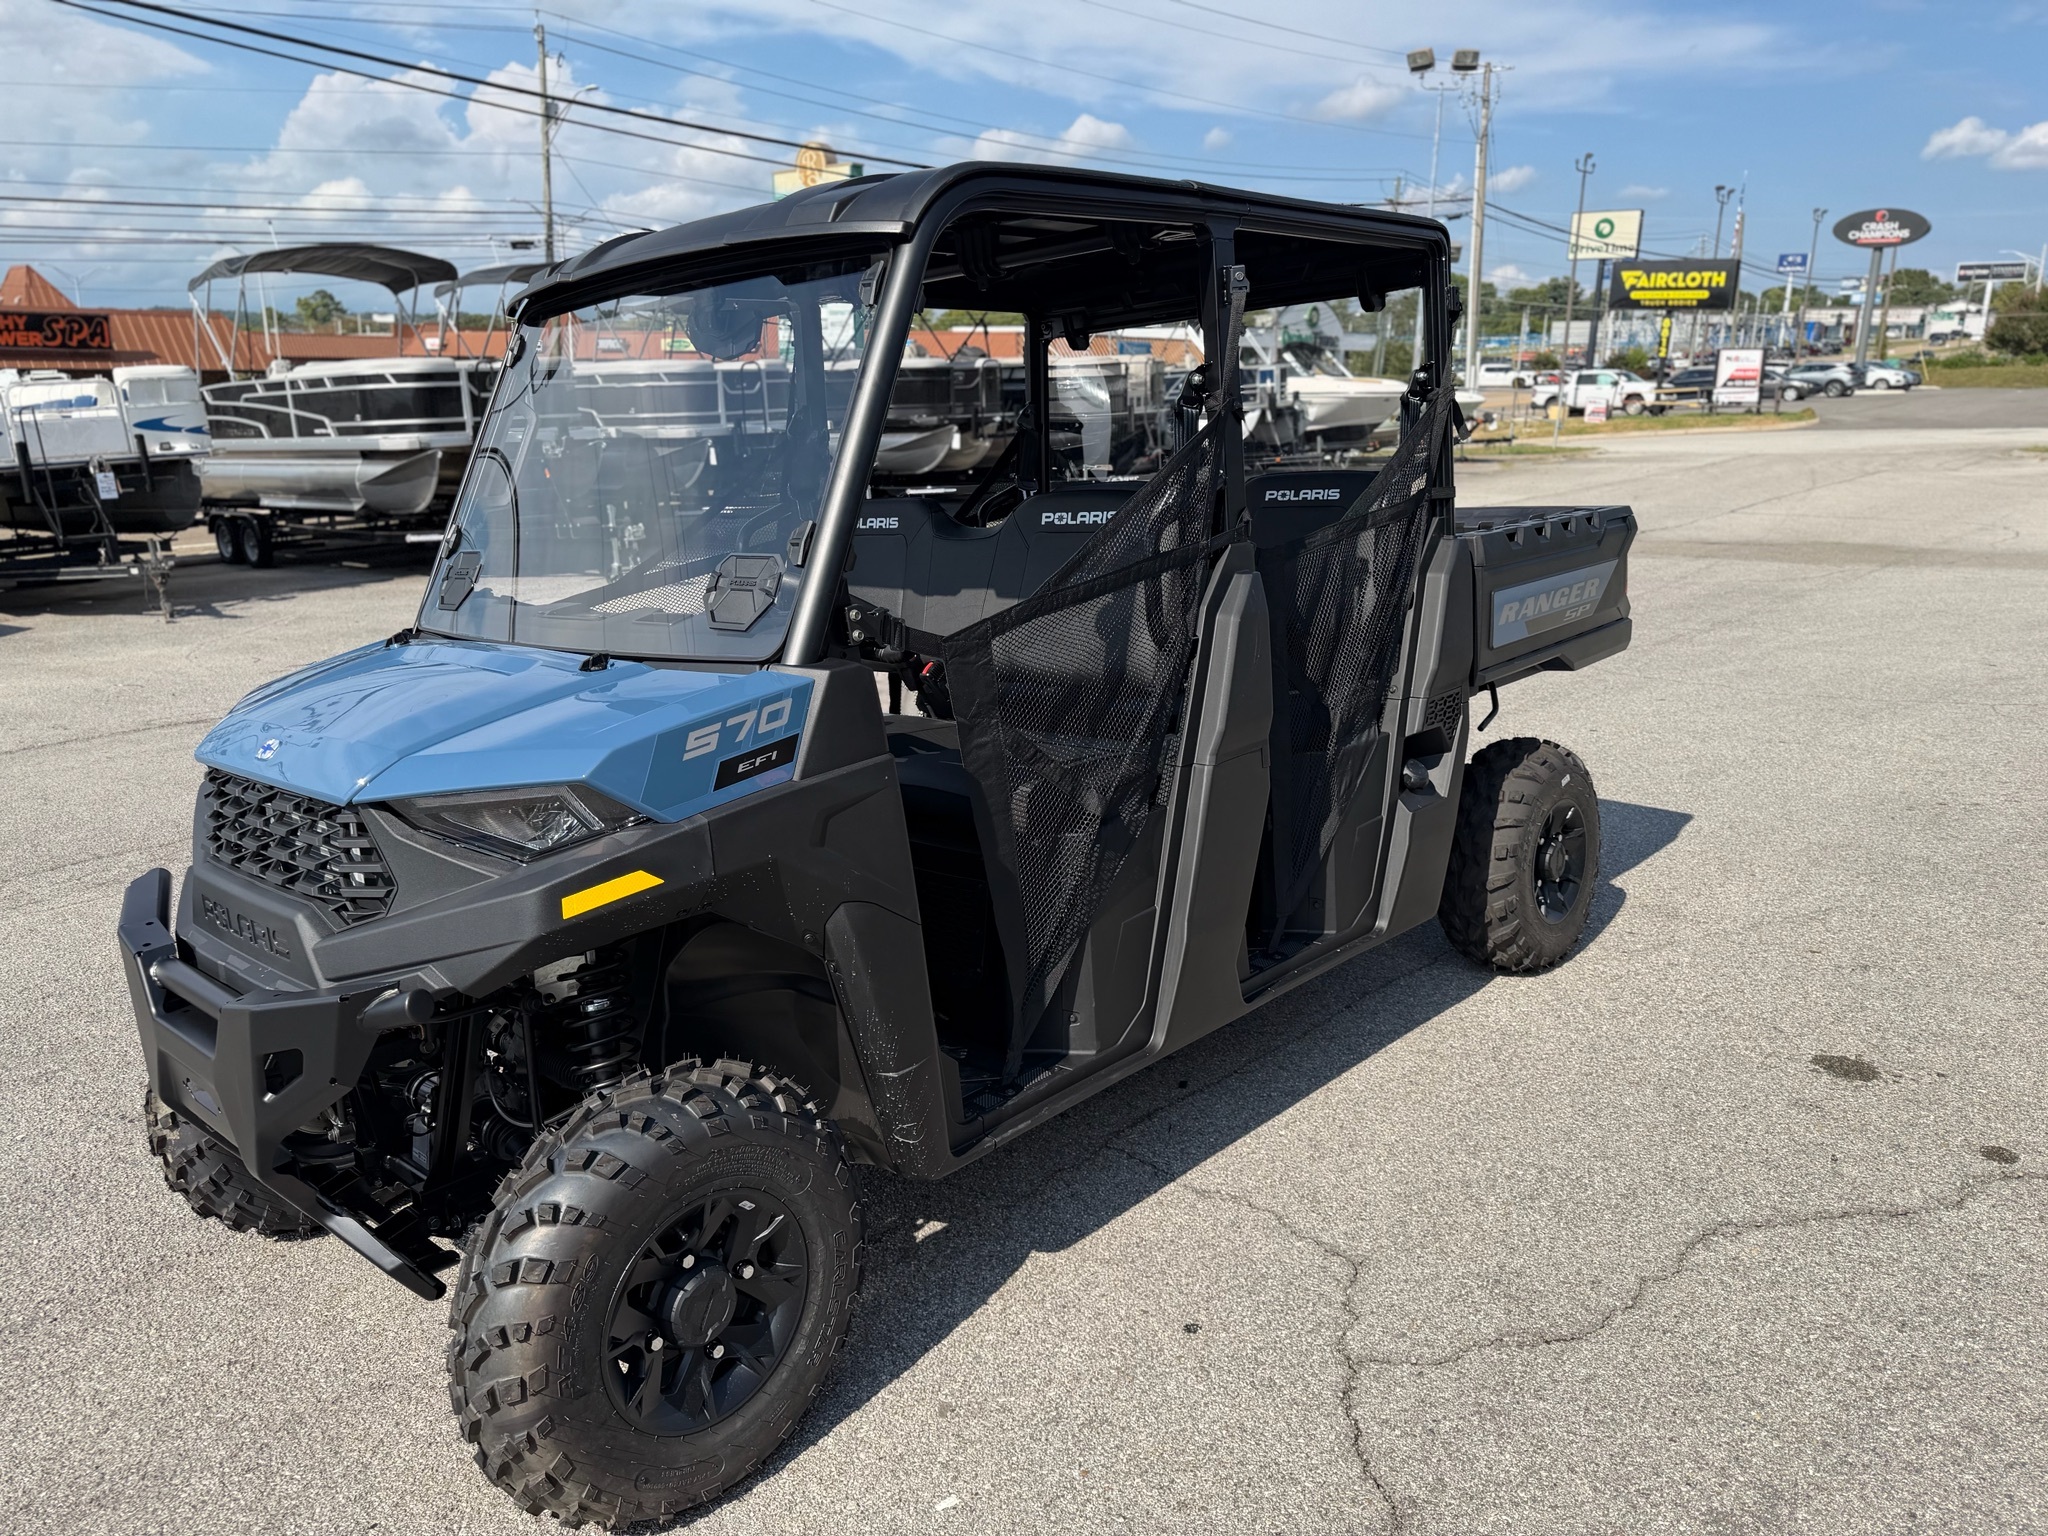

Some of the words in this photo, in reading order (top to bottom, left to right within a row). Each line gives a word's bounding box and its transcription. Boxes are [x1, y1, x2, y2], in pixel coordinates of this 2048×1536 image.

[1848, 228, 1910, 240] CHAMPIONS
[1862, 221, 1899, 231] CRASH
[1620, 270, 1726, 290] FAIRCLOTH
[42, 315, 110, 347] SPA
[1265, 489, 1340, 501] POLARIS
[856, 517, 899, 529] LARIS
[1498, 578, 1600, 626] RANGER
[1563, 603, 1591, 622] SP
[682, 698, 793, 762] 570
[737, 750, 778, 774] EFI
[201, 893, 291, 962] POLARIS
[806, 1229, 848, 1367] CARLSTAR
